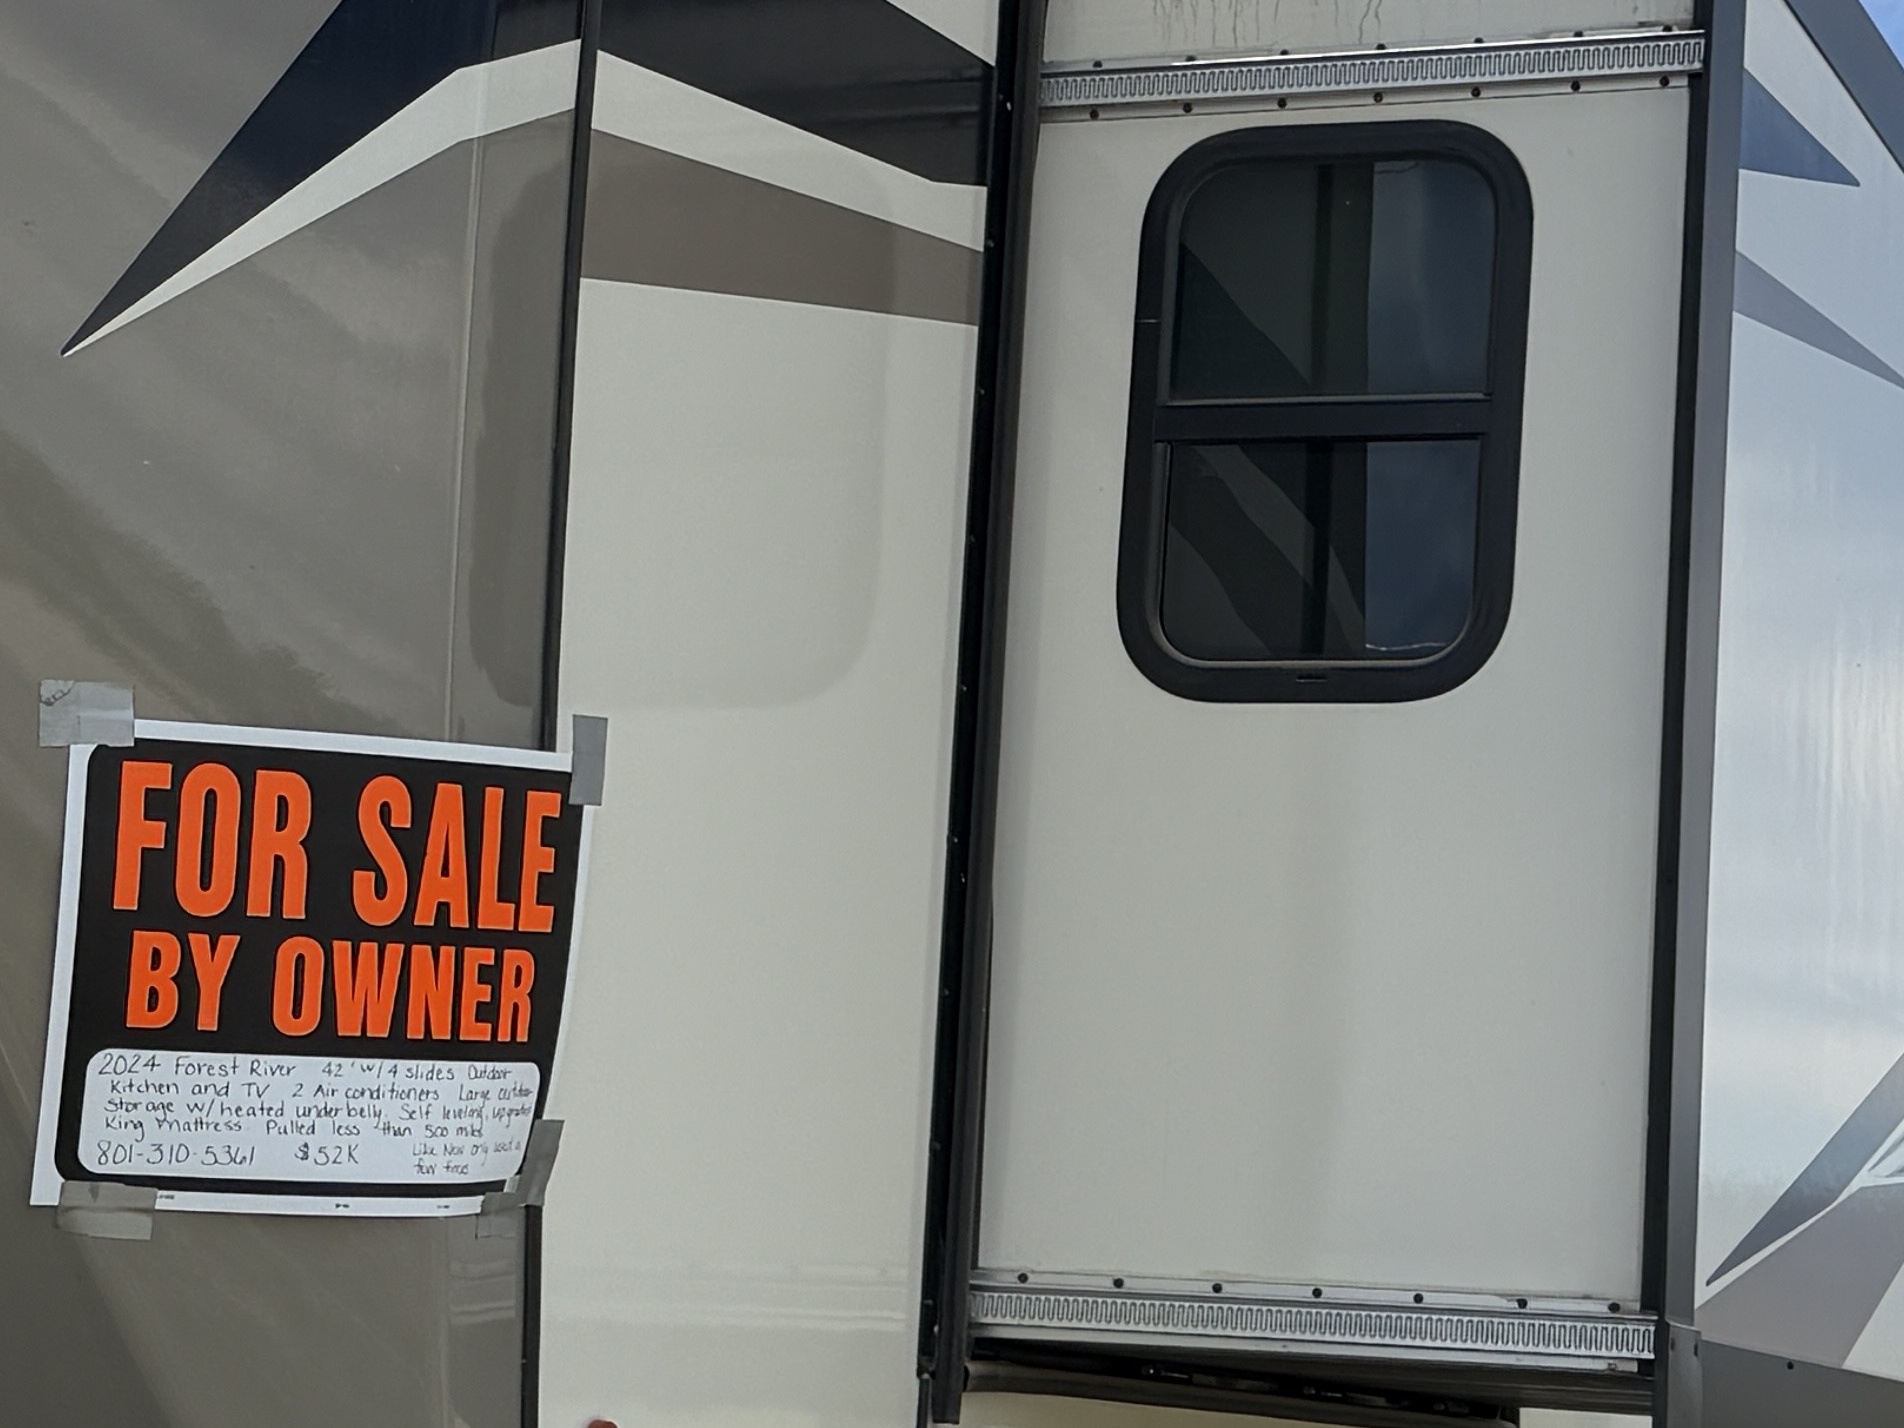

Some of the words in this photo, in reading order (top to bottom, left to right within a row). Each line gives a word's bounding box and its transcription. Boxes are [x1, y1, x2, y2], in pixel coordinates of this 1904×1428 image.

[112, 759, 313, 919] FOR
[351, 775, 563, 932] SALE
[125, 930, 241, 1032] BY
[272, 936, 535, 1043] OWNER
[98, 1053, 161, 1075] 2024
[174, 1055, 239, 1077] Forest
[249, 1059, 296, 1077] River
[405, 1064, 455, 1081] slides
[110, 1078, 179, 1095] Kitchen
[191, 1081, 230, 1098] and
[241, 1082, 270, 1099] TV
[291, 1083, 304, 1097] 2
[313, 1083, 338, 1098] Air
[344, 1082, 440, 1101] conditioners
[105, 1116, 145, 1142] King
[266, 1119, 316, 1135] Pulled
[332, 1119, 361, 1136] less
[424, 1124, 449, 1138] 500
[294, 1142, 359, 1166] $52K
